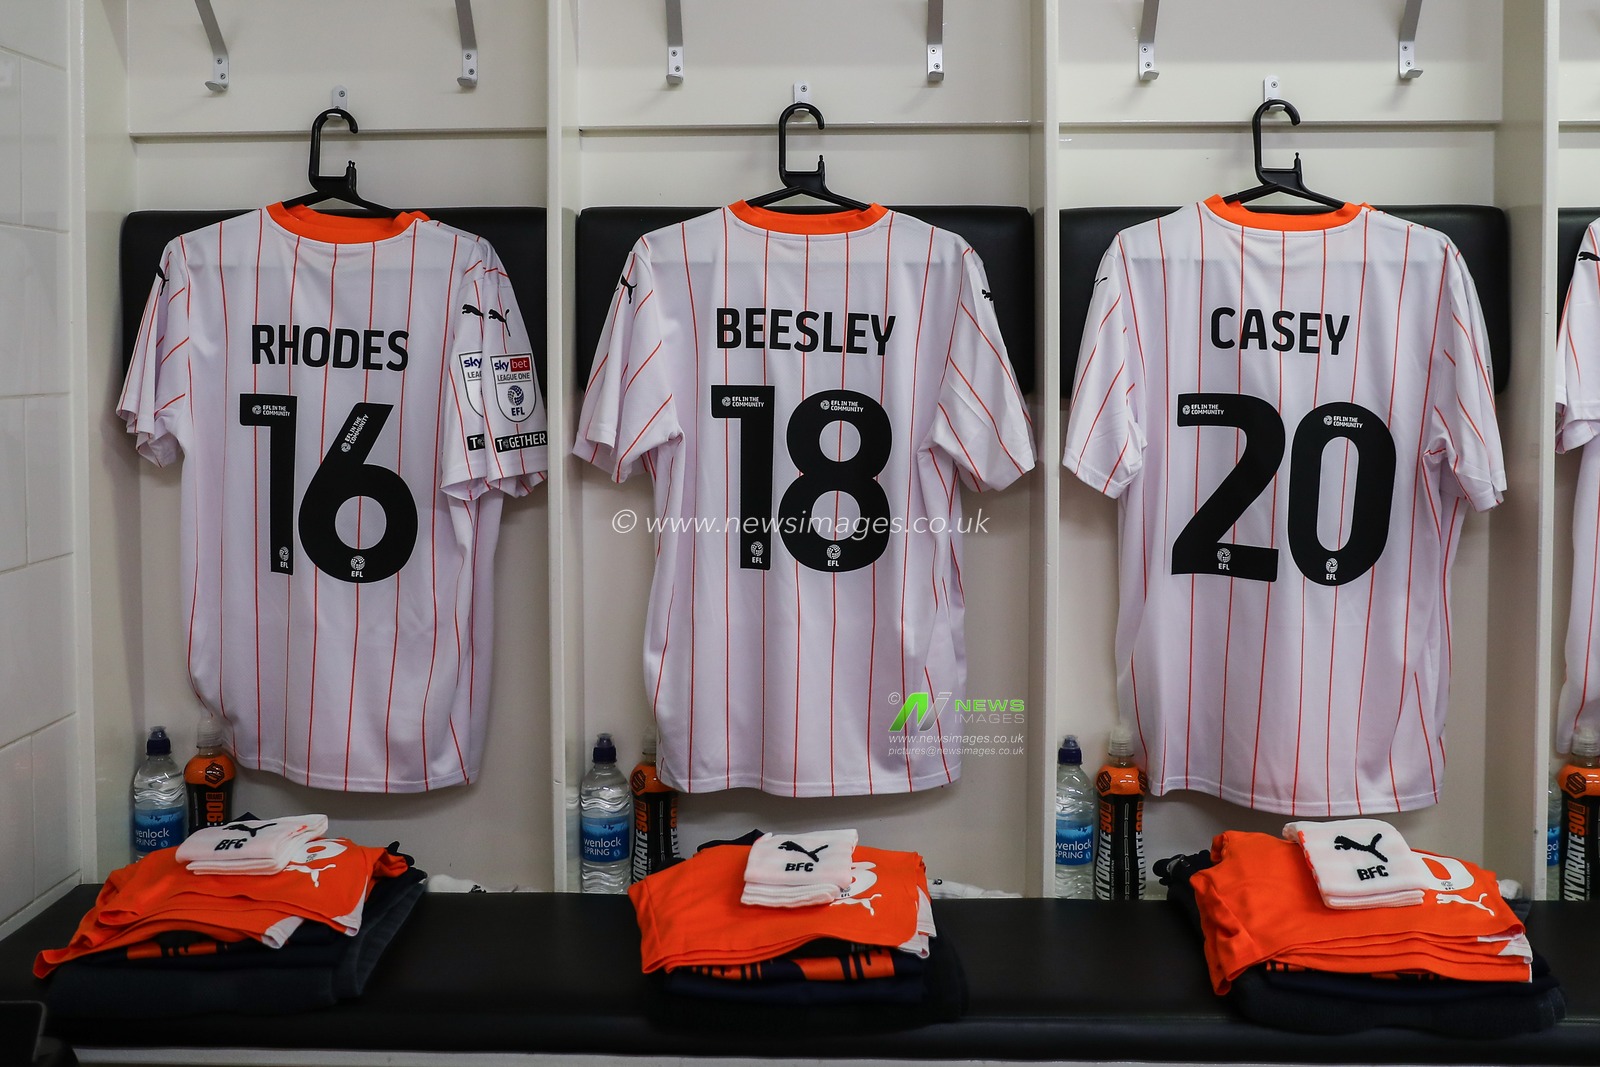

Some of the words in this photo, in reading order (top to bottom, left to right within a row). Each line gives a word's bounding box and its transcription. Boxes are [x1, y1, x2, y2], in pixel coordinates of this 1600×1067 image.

[716, 308, 896, 356] BEESLEY
[1211, 307, 1350, 355] CASEY
[252, 325, 409, 371] RHODES
[494, 360, 509, 372] sky
[511, 359, 528, 369] bet
[497, 373, 517, 381] LEAGUE
[518, 372, 530, 380] ONE
[511, 407, 525, 416] EFL
[350, 414, 369, 444] COMMUNITY
[711, 385, 892, 572] 18
[240, 393, 418, 584] 16
[1171, 393, 1397, 586] 20
[280, 561, 289, 569] EFL
[351, 570, 363, 578] EFL
[214, 838, 248, 851] BFC
[584, 836, 622, 848] wenlock
[785, 862, 814, 872] BFC
[1357, 865, 1389, 881] BFC
